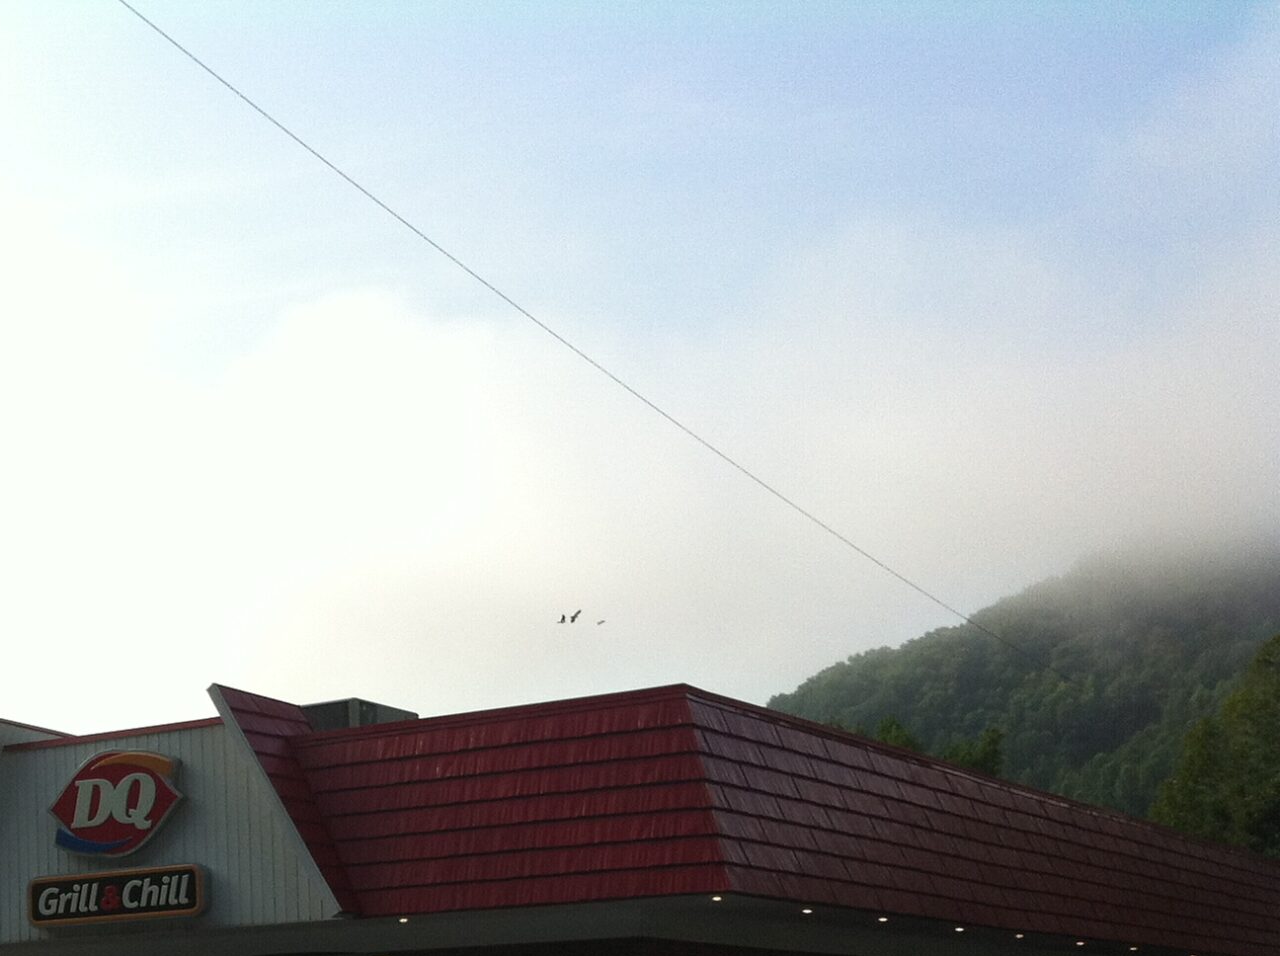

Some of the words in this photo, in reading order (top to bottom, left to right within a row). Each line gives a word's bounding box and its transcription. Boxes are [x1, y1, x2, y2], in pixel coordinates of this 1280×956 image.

[71, 772, 157, 830] DQ
[38, 883, 99, 916] Grill
[100, 885, 121, 911] &
[122, 874, 191, 909] Chill
